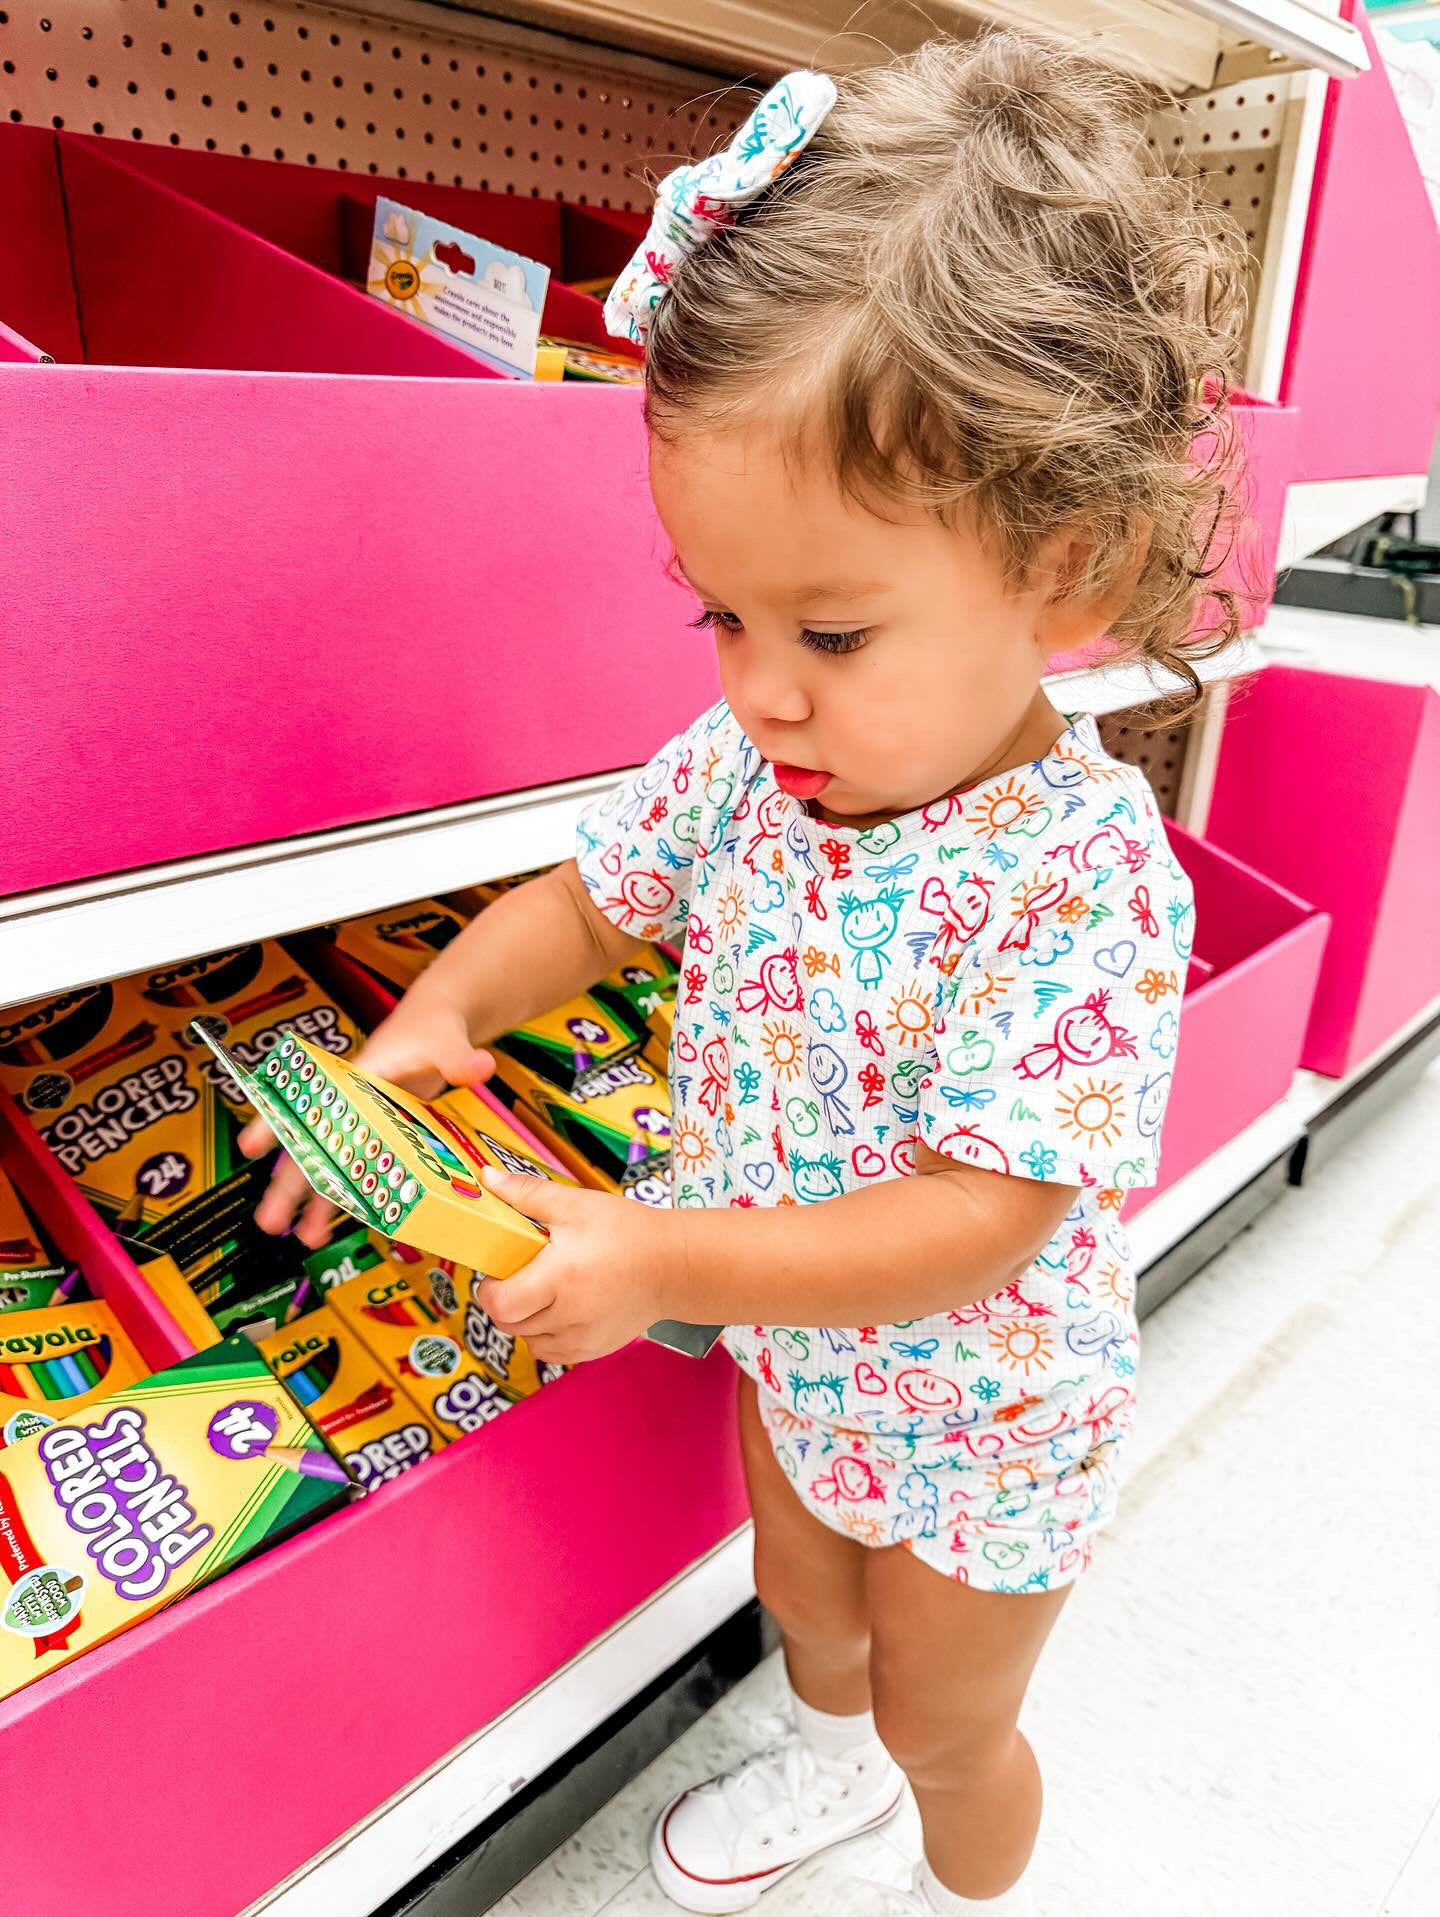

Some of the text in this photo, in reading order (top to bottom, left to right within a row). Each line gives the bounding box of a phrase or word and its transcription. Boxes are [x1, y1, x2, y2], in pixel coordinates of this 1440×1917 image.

[443, 285, 464, 302] Crayola
[466, 297, 480, 310] cares
[462, 318, 488, 336] products
[572, 1019, 604, 1042] 24
[58, 1081, 196, 1172] PENCILS
[141, 1155, 187, 1195] 24
[213, 1406, 273, 1454] 24
[89, 1409, 210, 1565] PENCILS
[44, 1428, 167, 1597] COLORED
[0, 1517, 30, 1572] Preferred by
[24, 1592, 43, 1620] WITH
[46, 1580, 68, 1608] WOOD
[11, 1601, 32, 1627] MADE
